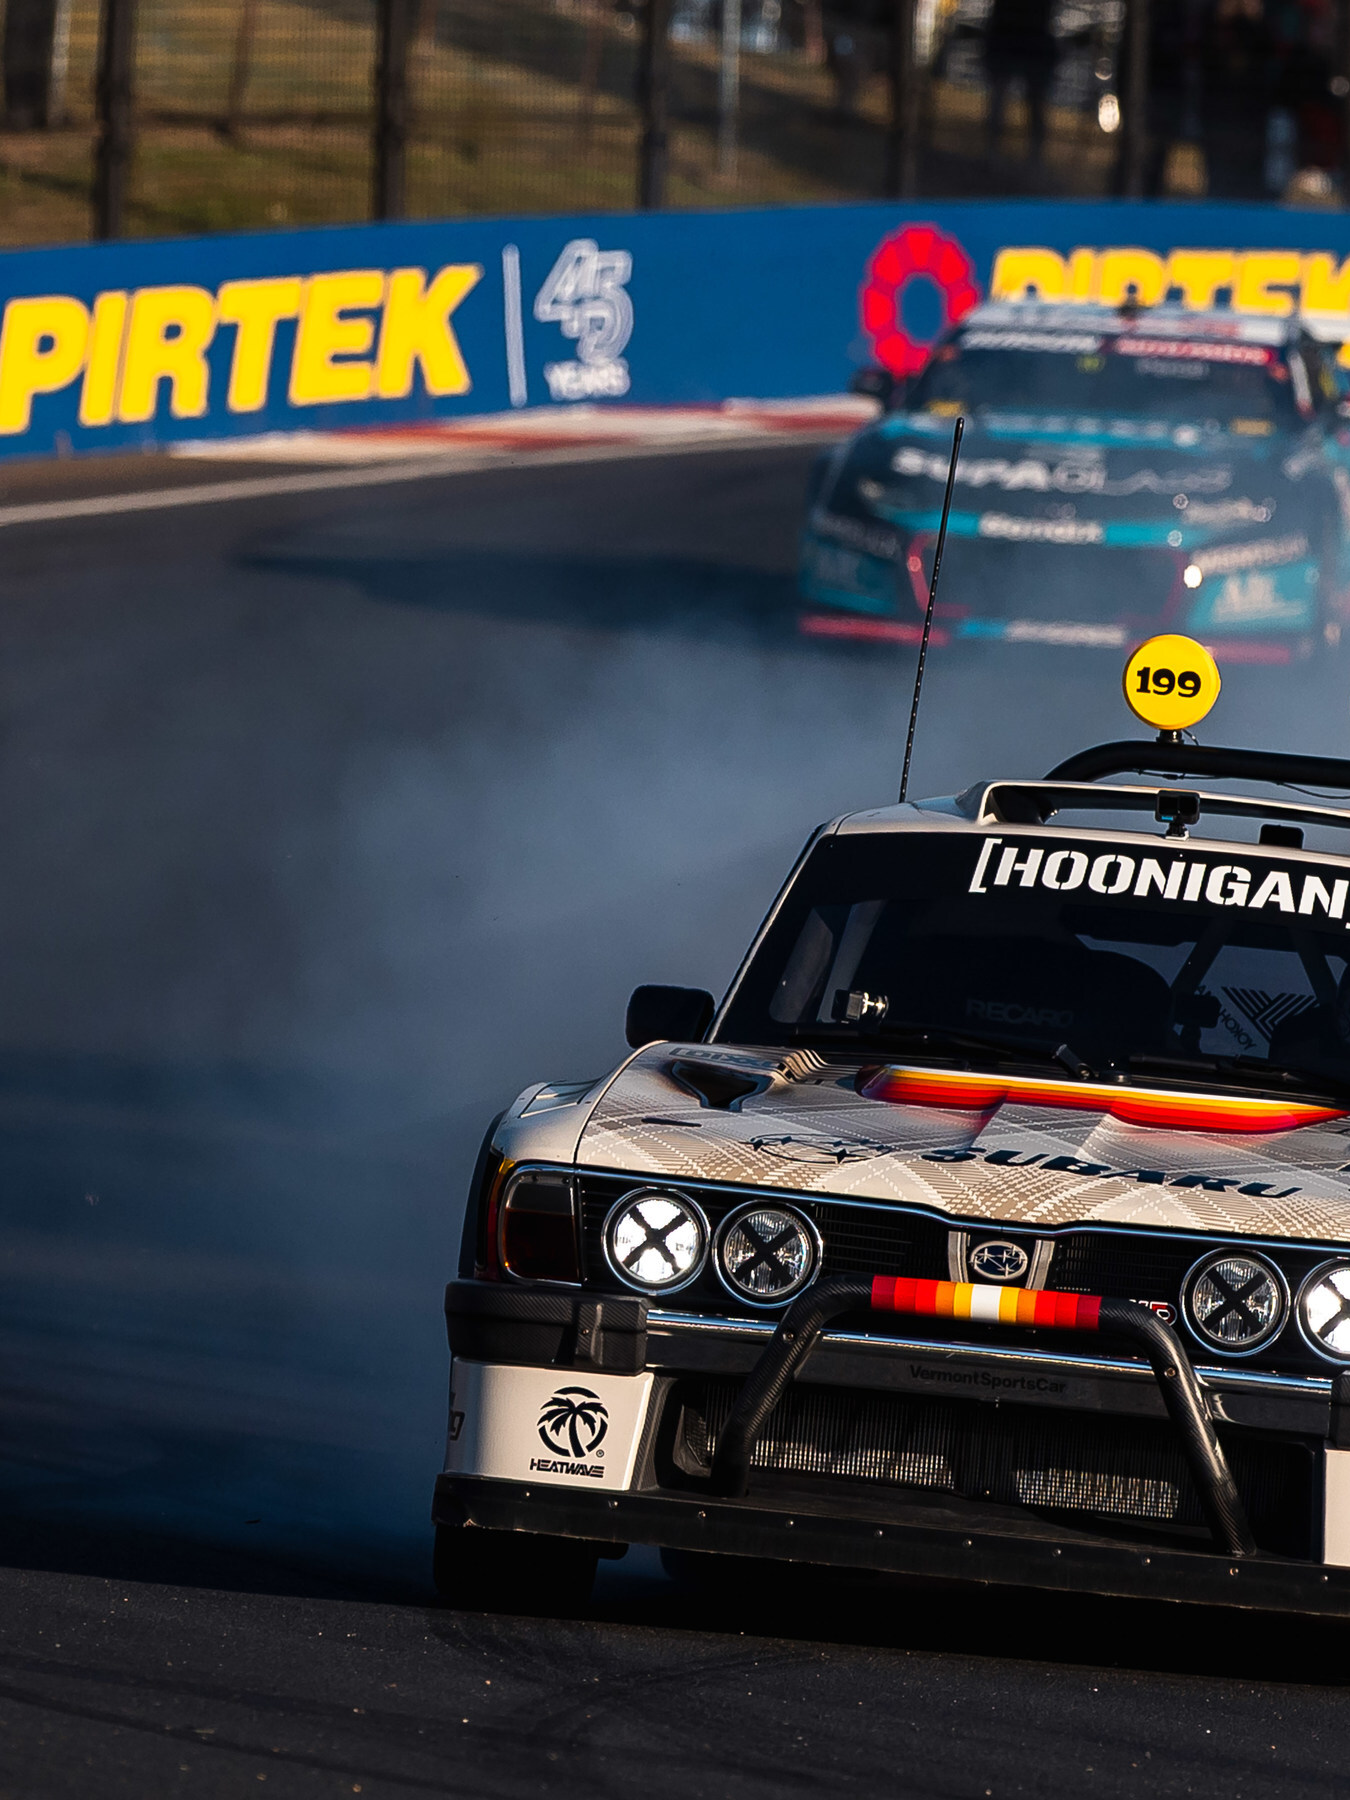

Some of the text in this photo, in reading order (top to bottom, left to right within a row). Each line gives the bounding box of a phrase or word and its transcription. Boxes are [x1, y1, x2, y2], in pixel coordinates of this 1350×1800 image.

[0, 264, 482, 434] PIRTEK
[1135, 665, 1202, 699] 199
[965, 998, 1074, 1028] RECARO
[920, 1147, 1303, 1198] SUBARU
[909, 1364, 1067, 1393] VermontSportsCar
[529, 1457, 605, 1479] HEATWAVE
